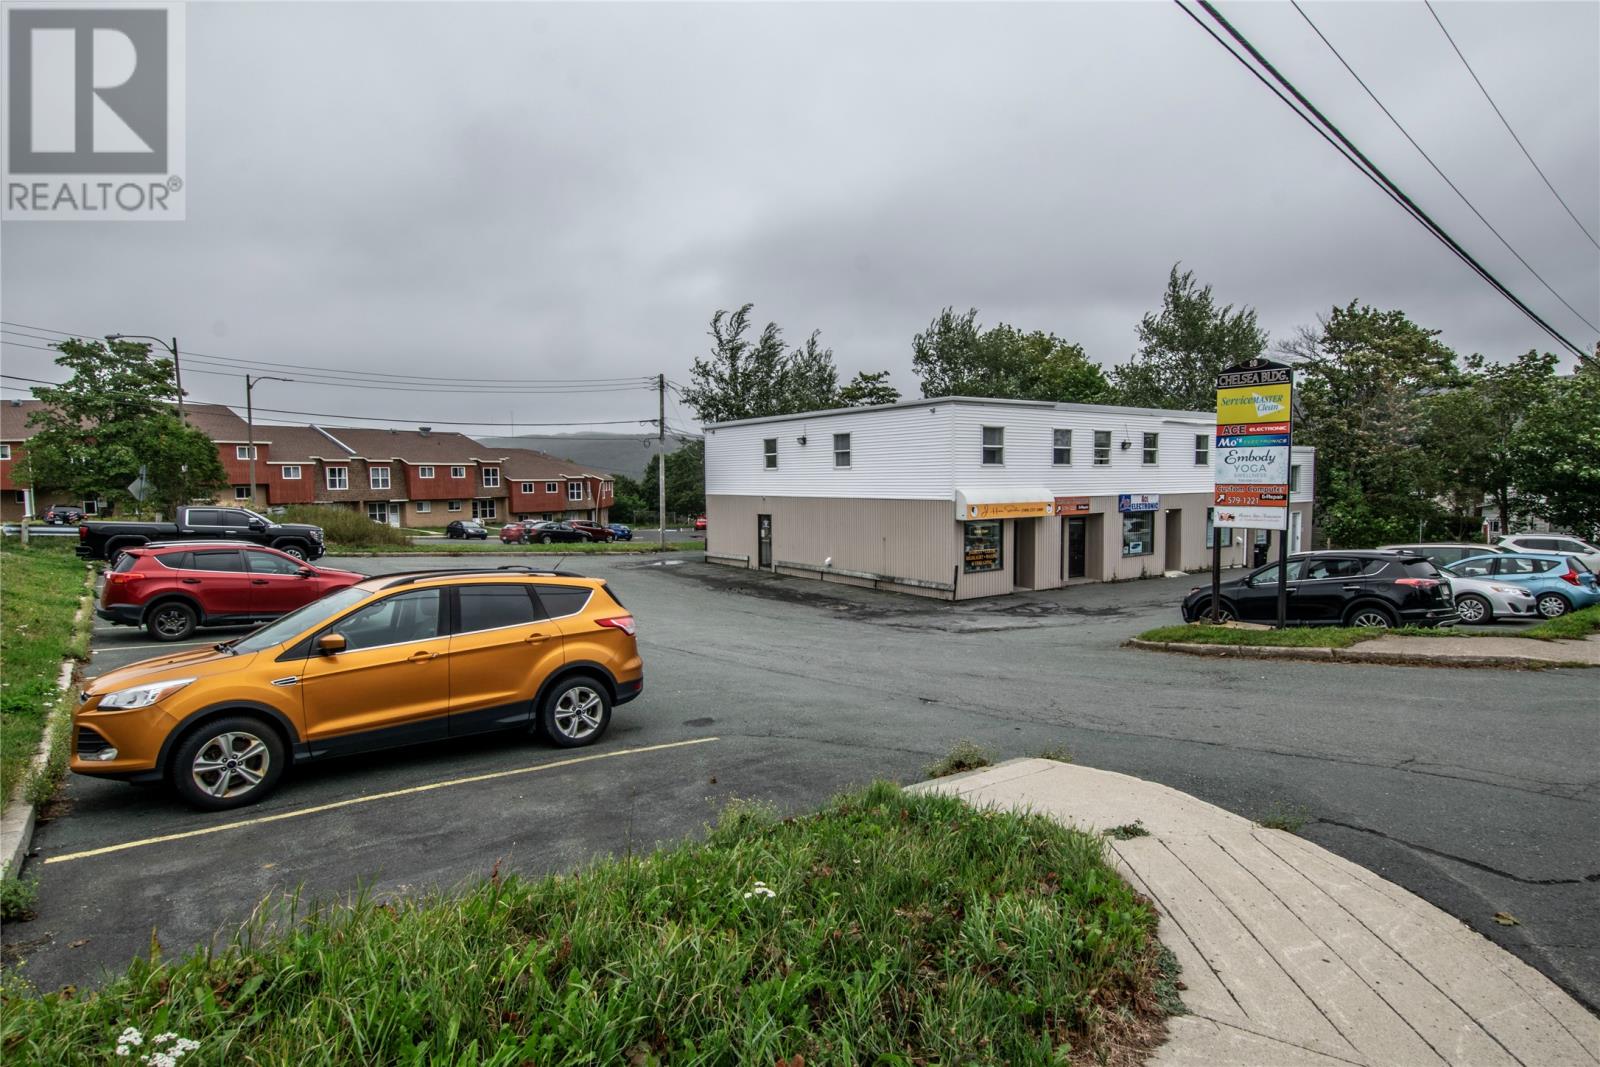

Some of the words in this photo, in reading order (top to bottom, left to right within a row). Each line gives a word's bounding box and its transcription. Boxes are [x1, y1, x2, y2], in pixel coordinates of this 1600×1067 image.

[1219, 373, 1259, 385] CHELSEA
[1261, 371, 1288, 382] BLDG.
[1222, 425, 1246, 435] ACE
[1218, 438, 1242, 447] Mo's
[1224, 449, 1276, 465] Embody
[1234, 464, 1267, 473] YOGA
[1217, 485, 1245, 493] Custom
[1247, 485, 1284, 494] Computer
